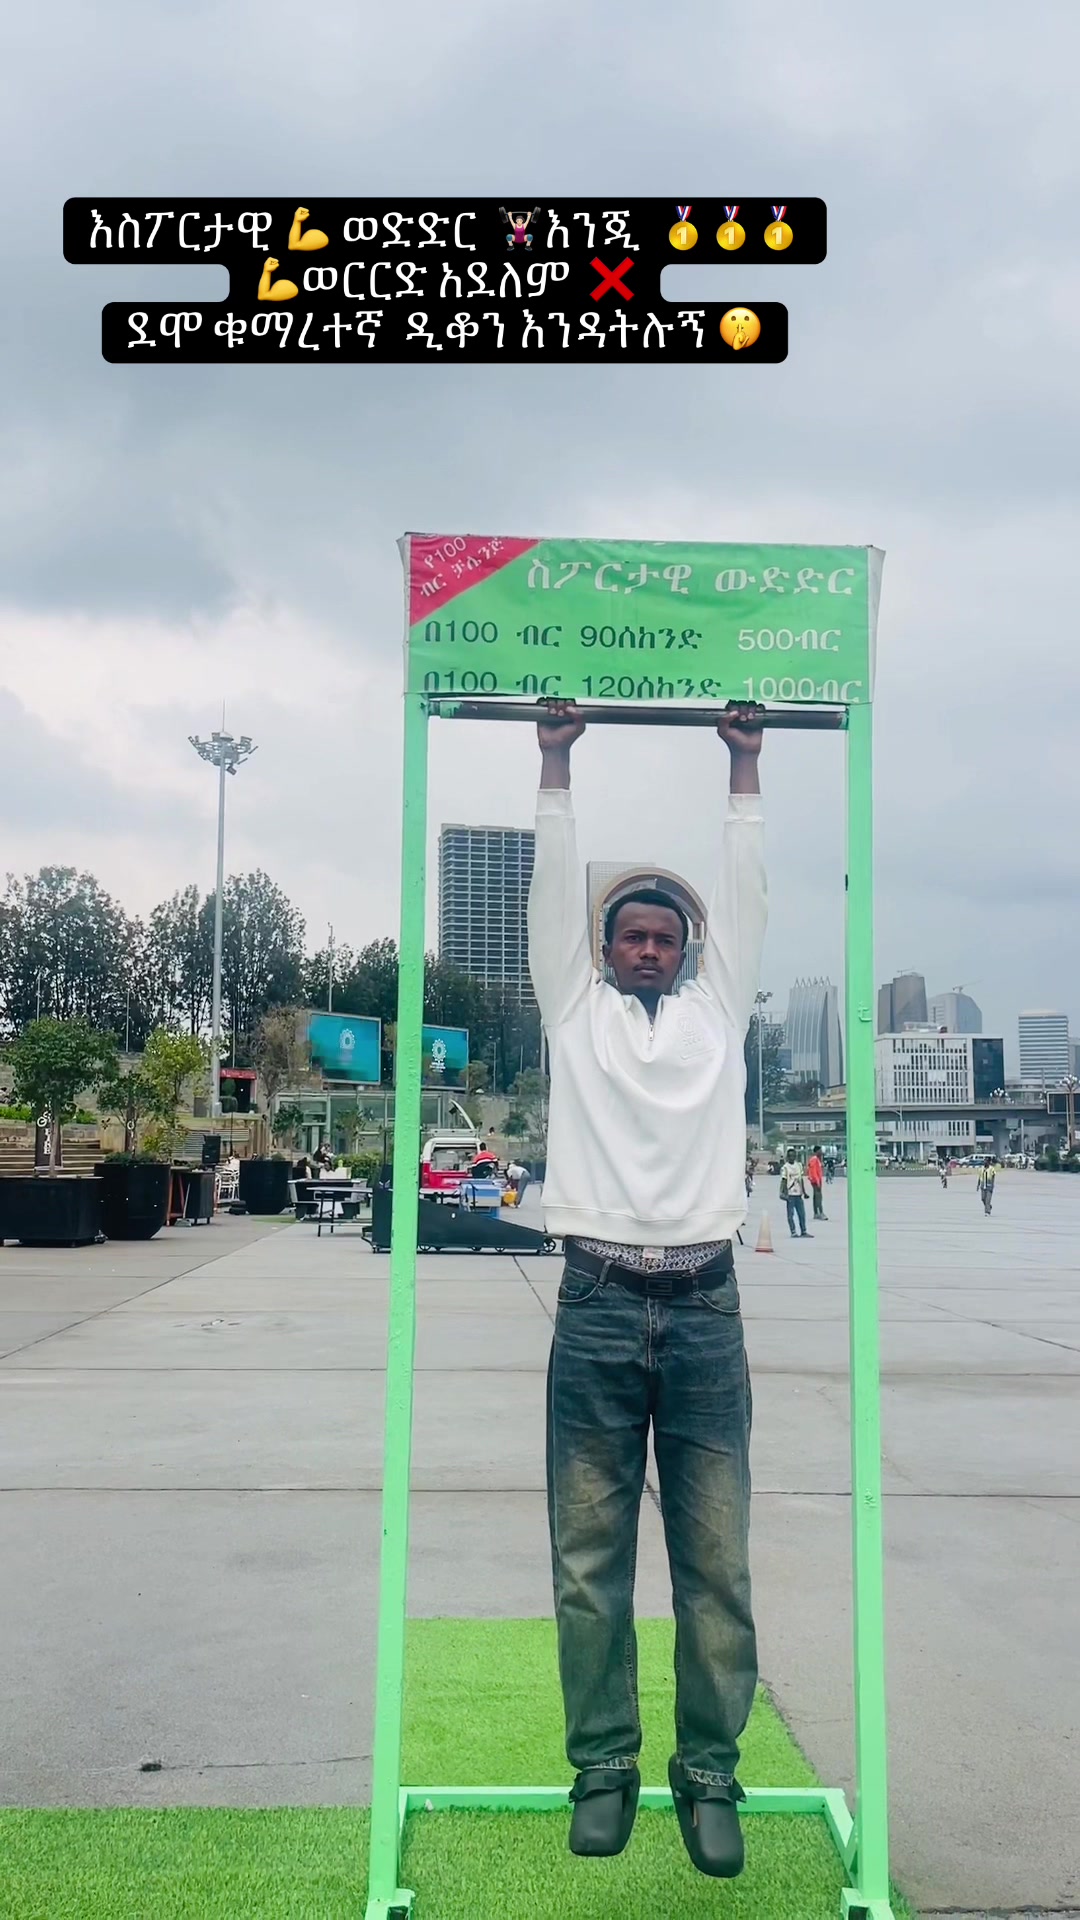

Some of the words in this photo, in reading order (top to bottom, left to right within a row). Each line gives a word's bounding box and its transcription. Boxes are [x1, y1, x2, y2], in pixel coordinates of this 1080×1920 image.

[424, 536, 466, 569] የ100
[420, 573, 447, 597] ብር
[527, 558, 694, 595] ስፖርታዊ
[714, 566, 856, 596] ውድድር
[424, 620, 499, 643] በ100
[516, 624, 562, 647] ብር
[580, 625, 703, 649] 90ሰከንድ
[737, 628, 842, 652] 500ብር
[424, 670, 498, 692] በ100
[515, 674, 562, 696] ብር
